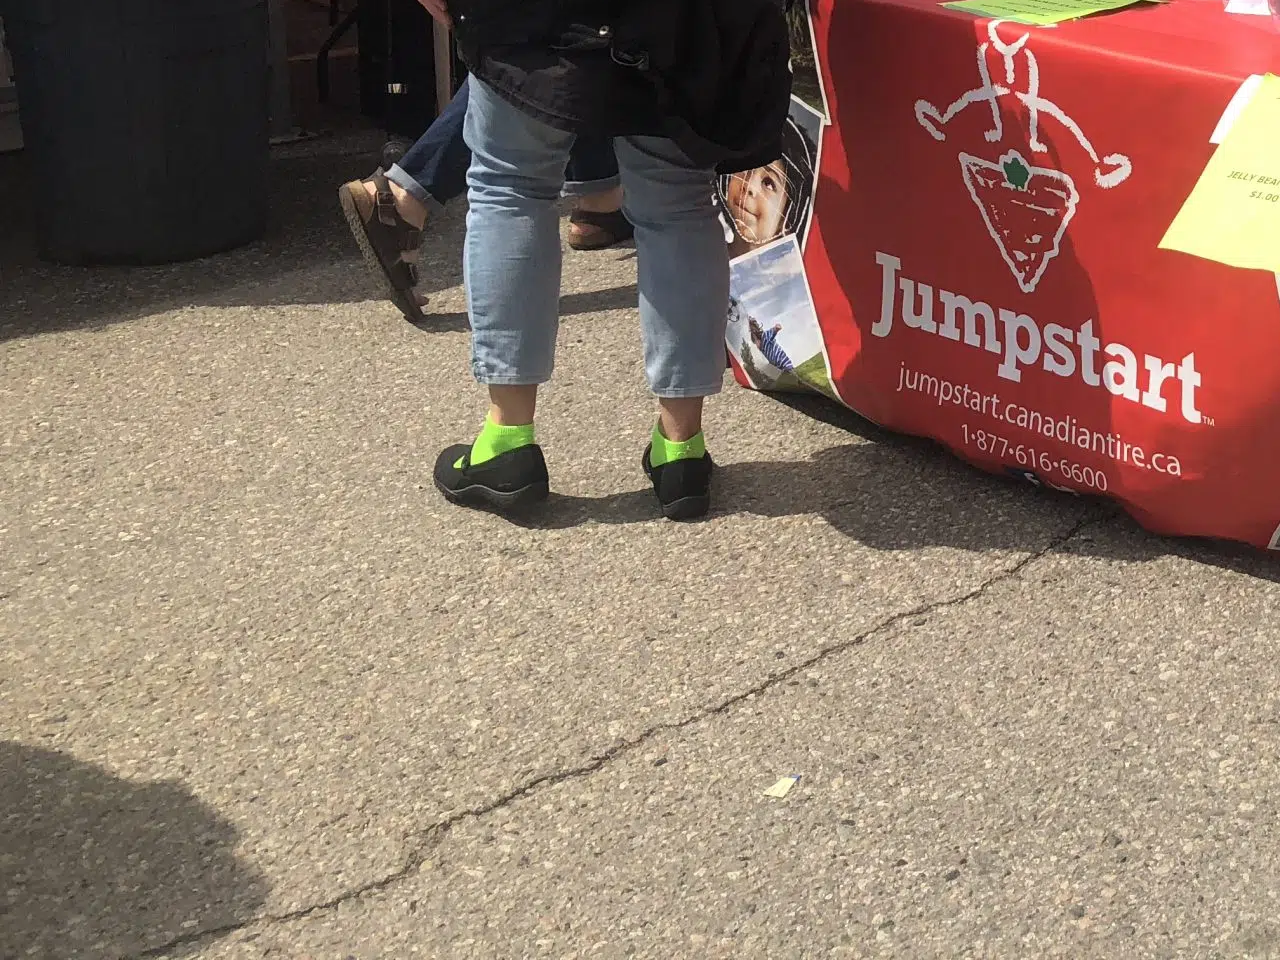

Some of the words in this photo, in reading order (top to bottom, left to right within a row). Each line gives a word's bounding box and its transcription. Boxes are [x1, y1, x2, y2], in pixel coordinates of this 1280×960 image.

[1227, 171, 1257, 183] JELLY
[1249, 191, 1280, 203] $1.00
[871, 251, 1202, 425] Jumpstart
[896, 361, 1183, 477] jumpstart.canadiantire.ca
